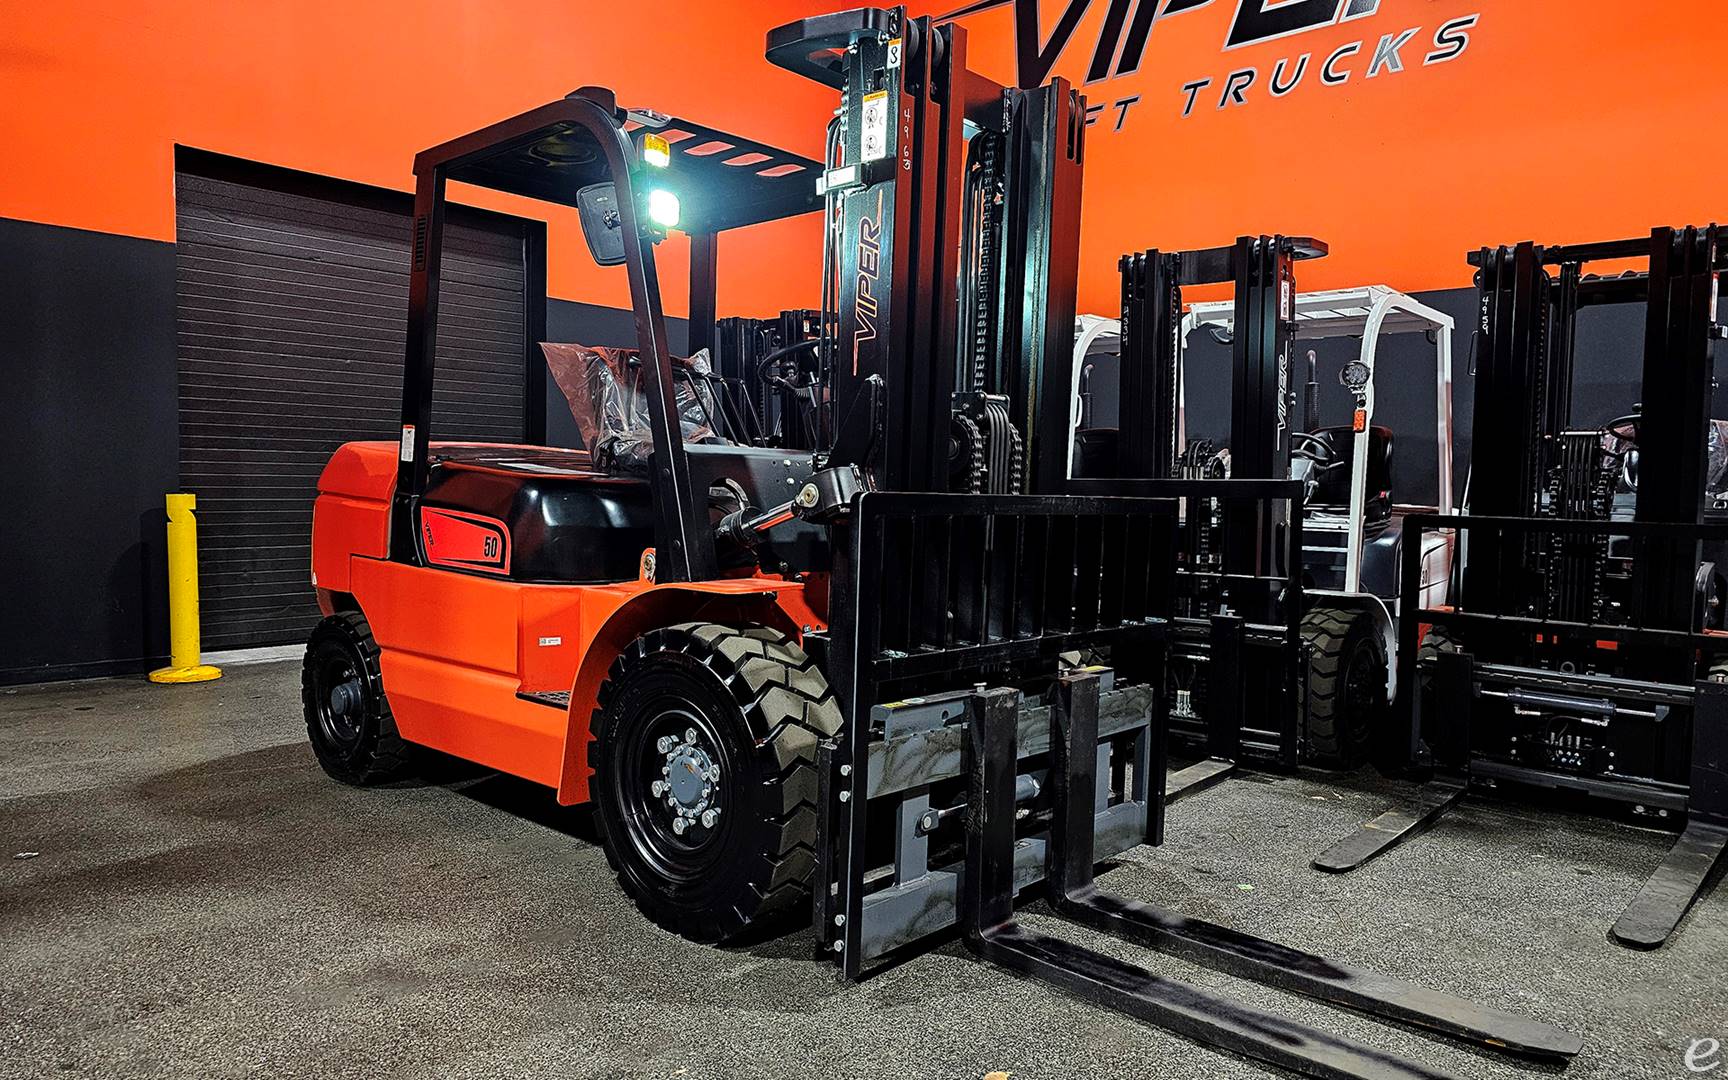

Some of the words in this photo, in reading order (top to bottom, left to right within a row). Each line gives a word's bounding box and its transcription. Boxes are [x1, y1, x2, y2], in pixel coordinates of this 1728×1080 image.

[1181, 14, 1480, 118] TRUCKS
[903, 108, 912, 170] 4963
[854, 189, 883, 377] VIPER
[1277, 340, 1288, 451] VIPER
[483, 535, 498, 558] 50
